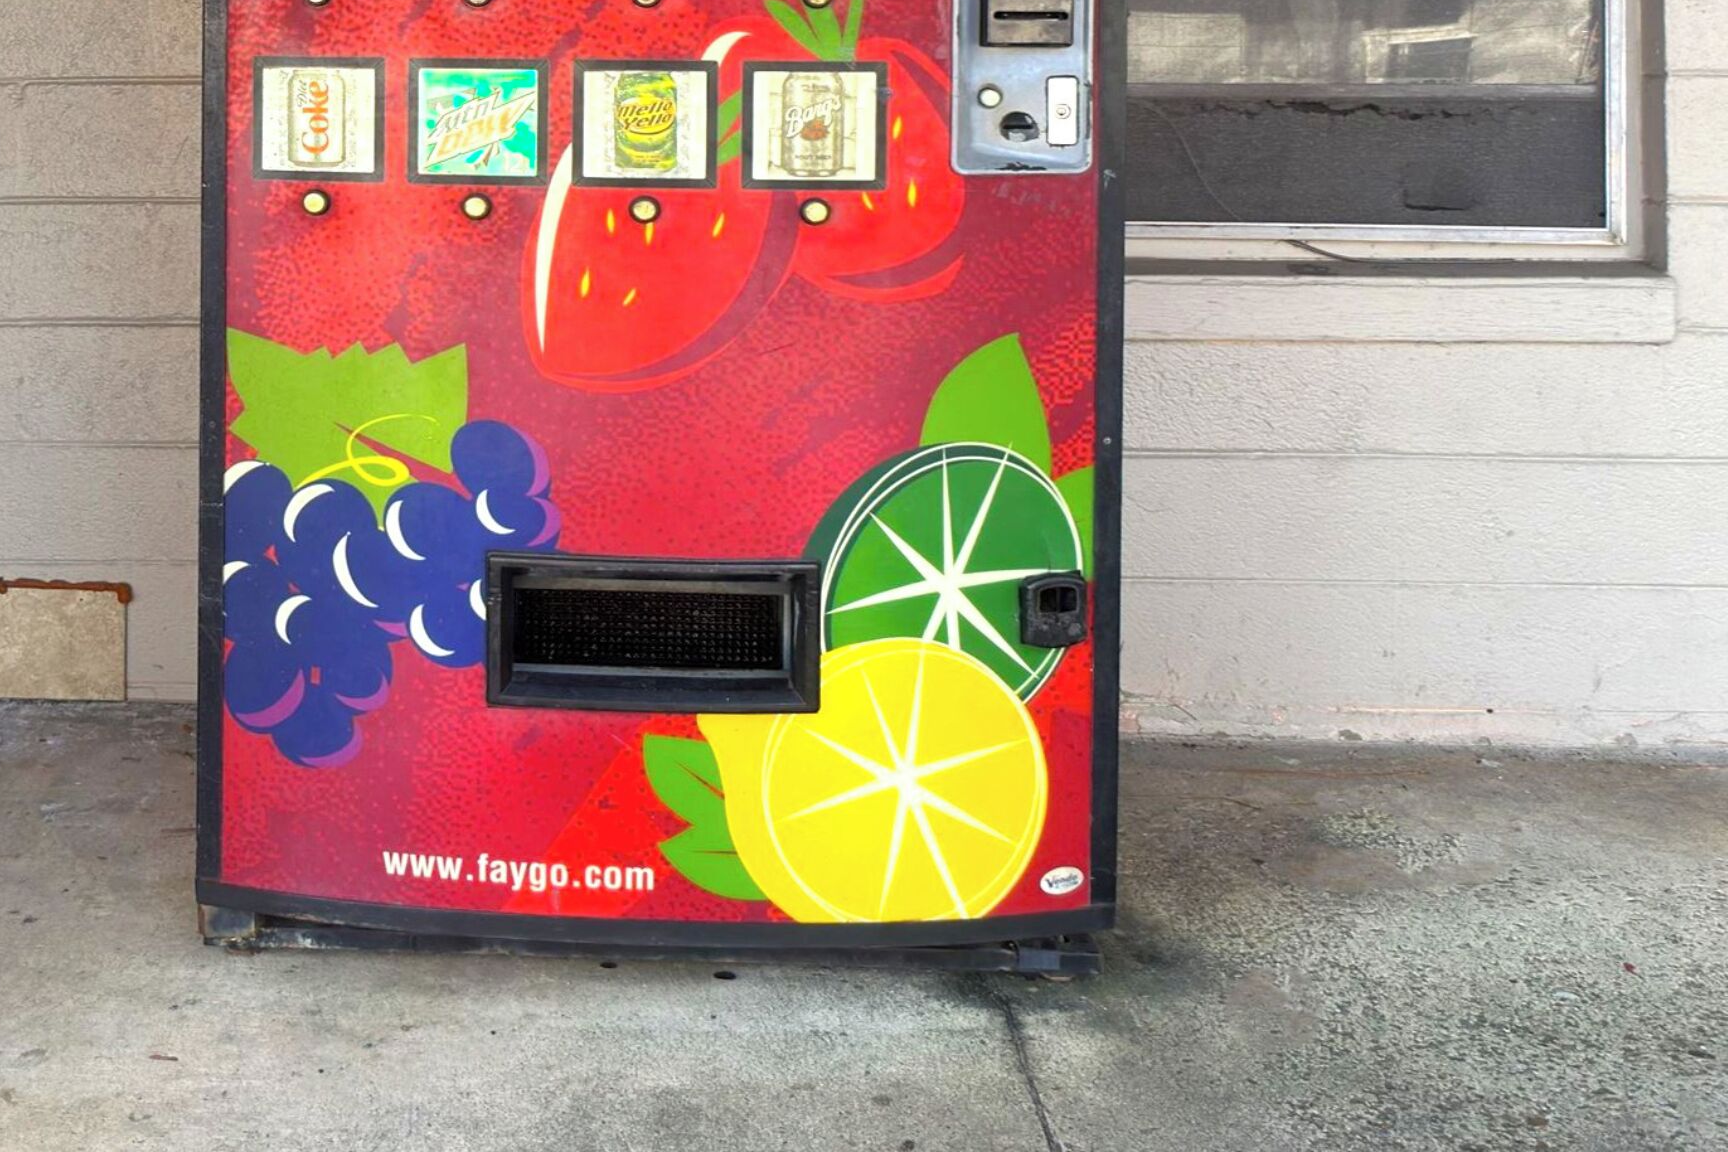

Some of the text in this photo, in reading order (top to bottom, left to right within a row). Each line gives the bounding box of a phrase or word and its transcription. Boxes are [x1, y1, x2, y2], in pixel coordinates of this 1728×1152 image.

[302, 80, 329, 155] Coke
[618, 100, 673, 118] Mello
[622, 113, 672, 130] Yello
[383, 850, 654, 892] www.faygo.com
